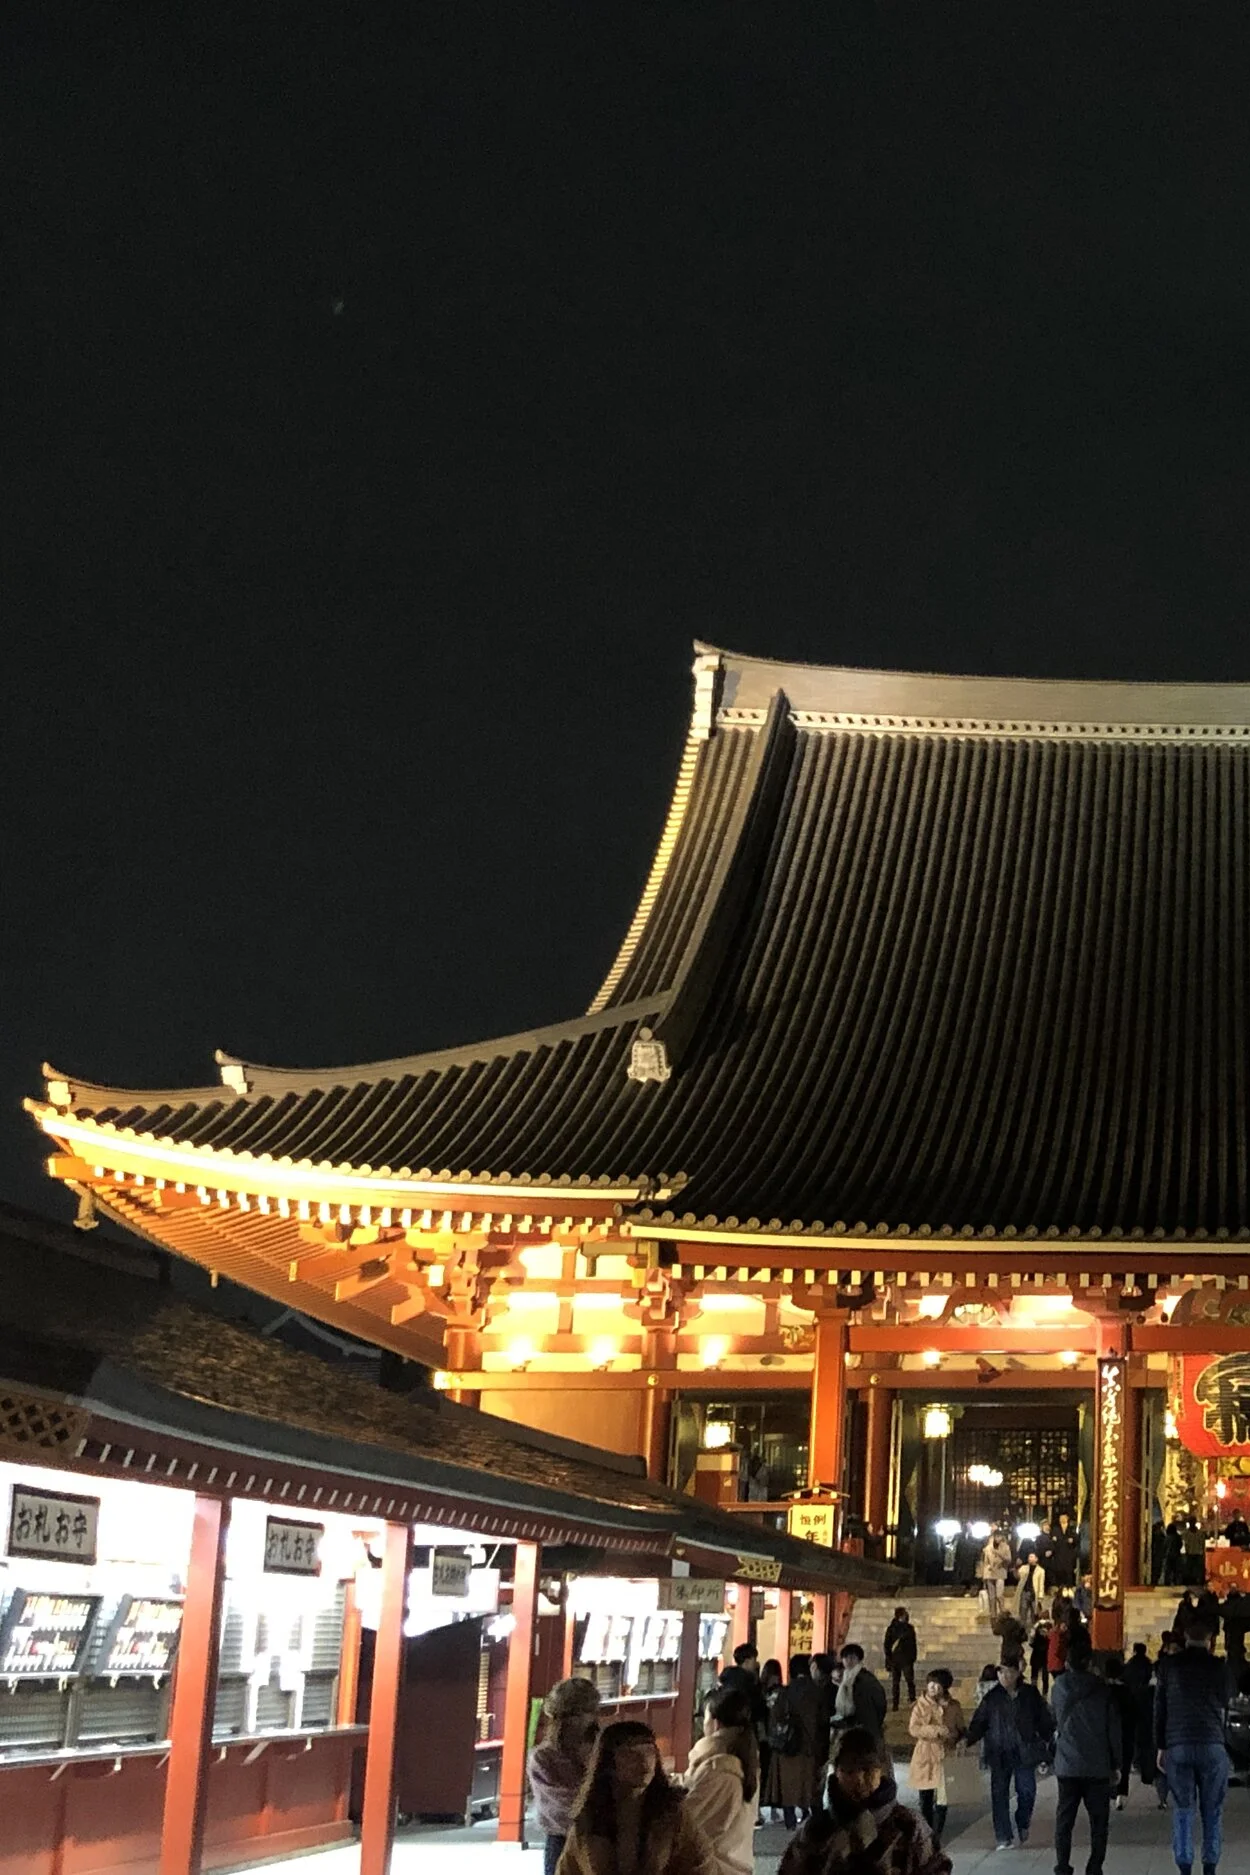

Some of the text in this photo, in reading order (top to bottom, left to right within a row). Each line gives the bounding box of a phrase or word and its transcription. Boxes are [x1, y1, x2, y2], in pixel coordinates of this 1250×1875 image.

[16, 1502, 88, 1549] お札お守
[267, 1529, 315, 1565] お札お守
